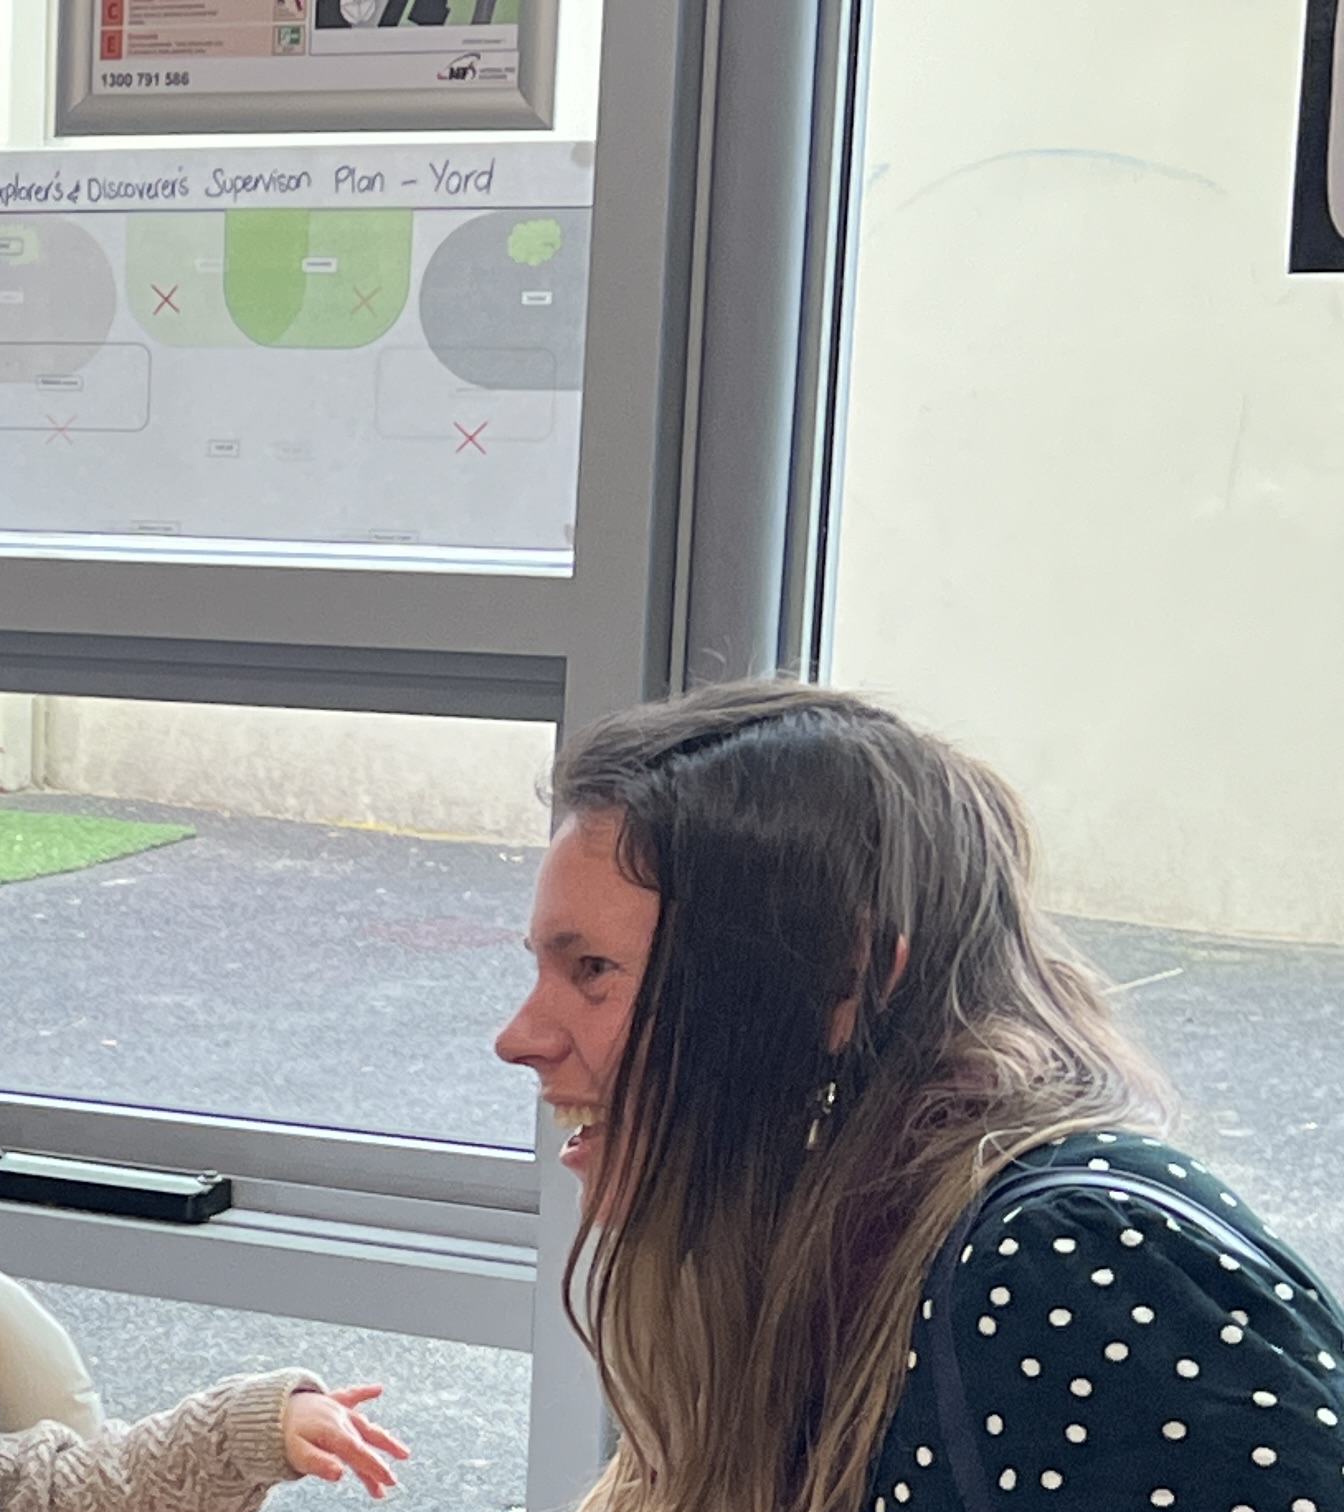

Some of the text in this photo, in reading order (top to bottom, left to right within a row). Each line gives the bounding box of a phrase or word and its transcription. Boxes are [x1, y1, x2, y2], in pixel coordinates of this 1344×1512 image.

[101, 71, 189, 88] 1300 791 586
[334, 165, 385, 194] Plan
